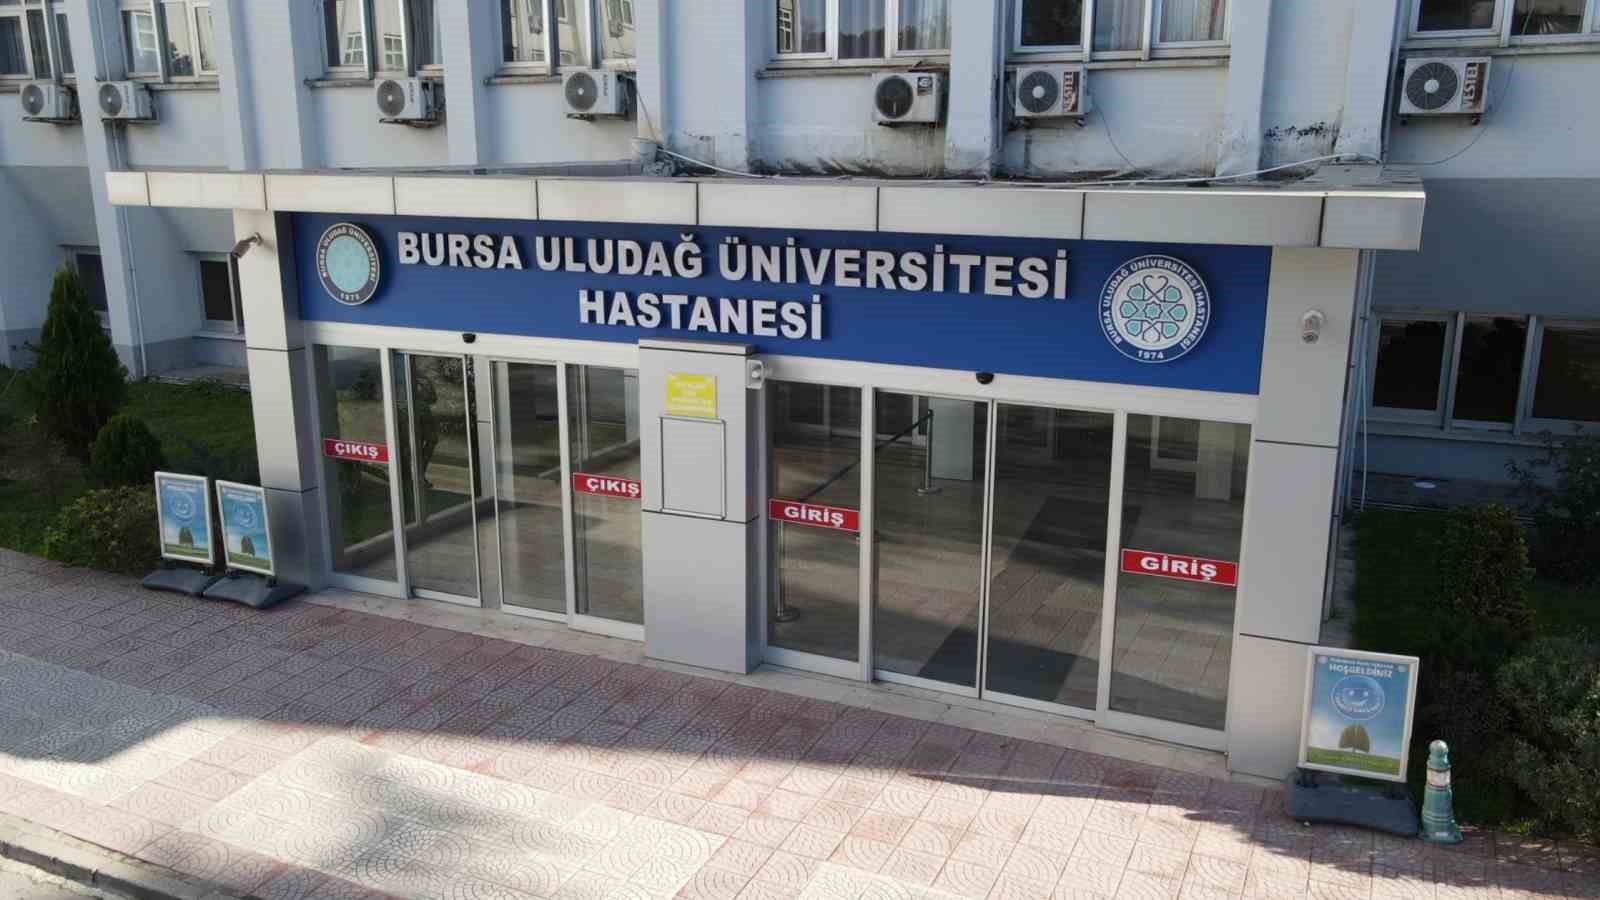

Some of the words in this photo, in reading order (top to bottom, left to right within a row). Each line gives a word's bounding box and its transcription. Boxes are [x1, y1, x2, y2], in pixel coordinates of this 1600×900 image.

[397, 230, 523, 270] BURSA
[535, 233, 703, 278] ULUDAĞ
[718, 236, 1069, 300] ÜNİVERSİTESİ
[578, 288, 824, 341] HASTANESİ
[1103, 310, 1122, 345] BURSA
[1138, 350, 1164, 359] 1974
[335, 442, 379, 459] ÇIKIŞ
[586, 478, 640, 498] ÇIKIŞ
[784, 504, 845, 528] GİRİŞ
[1140, 555, 1217, 581] GİRİŞ
